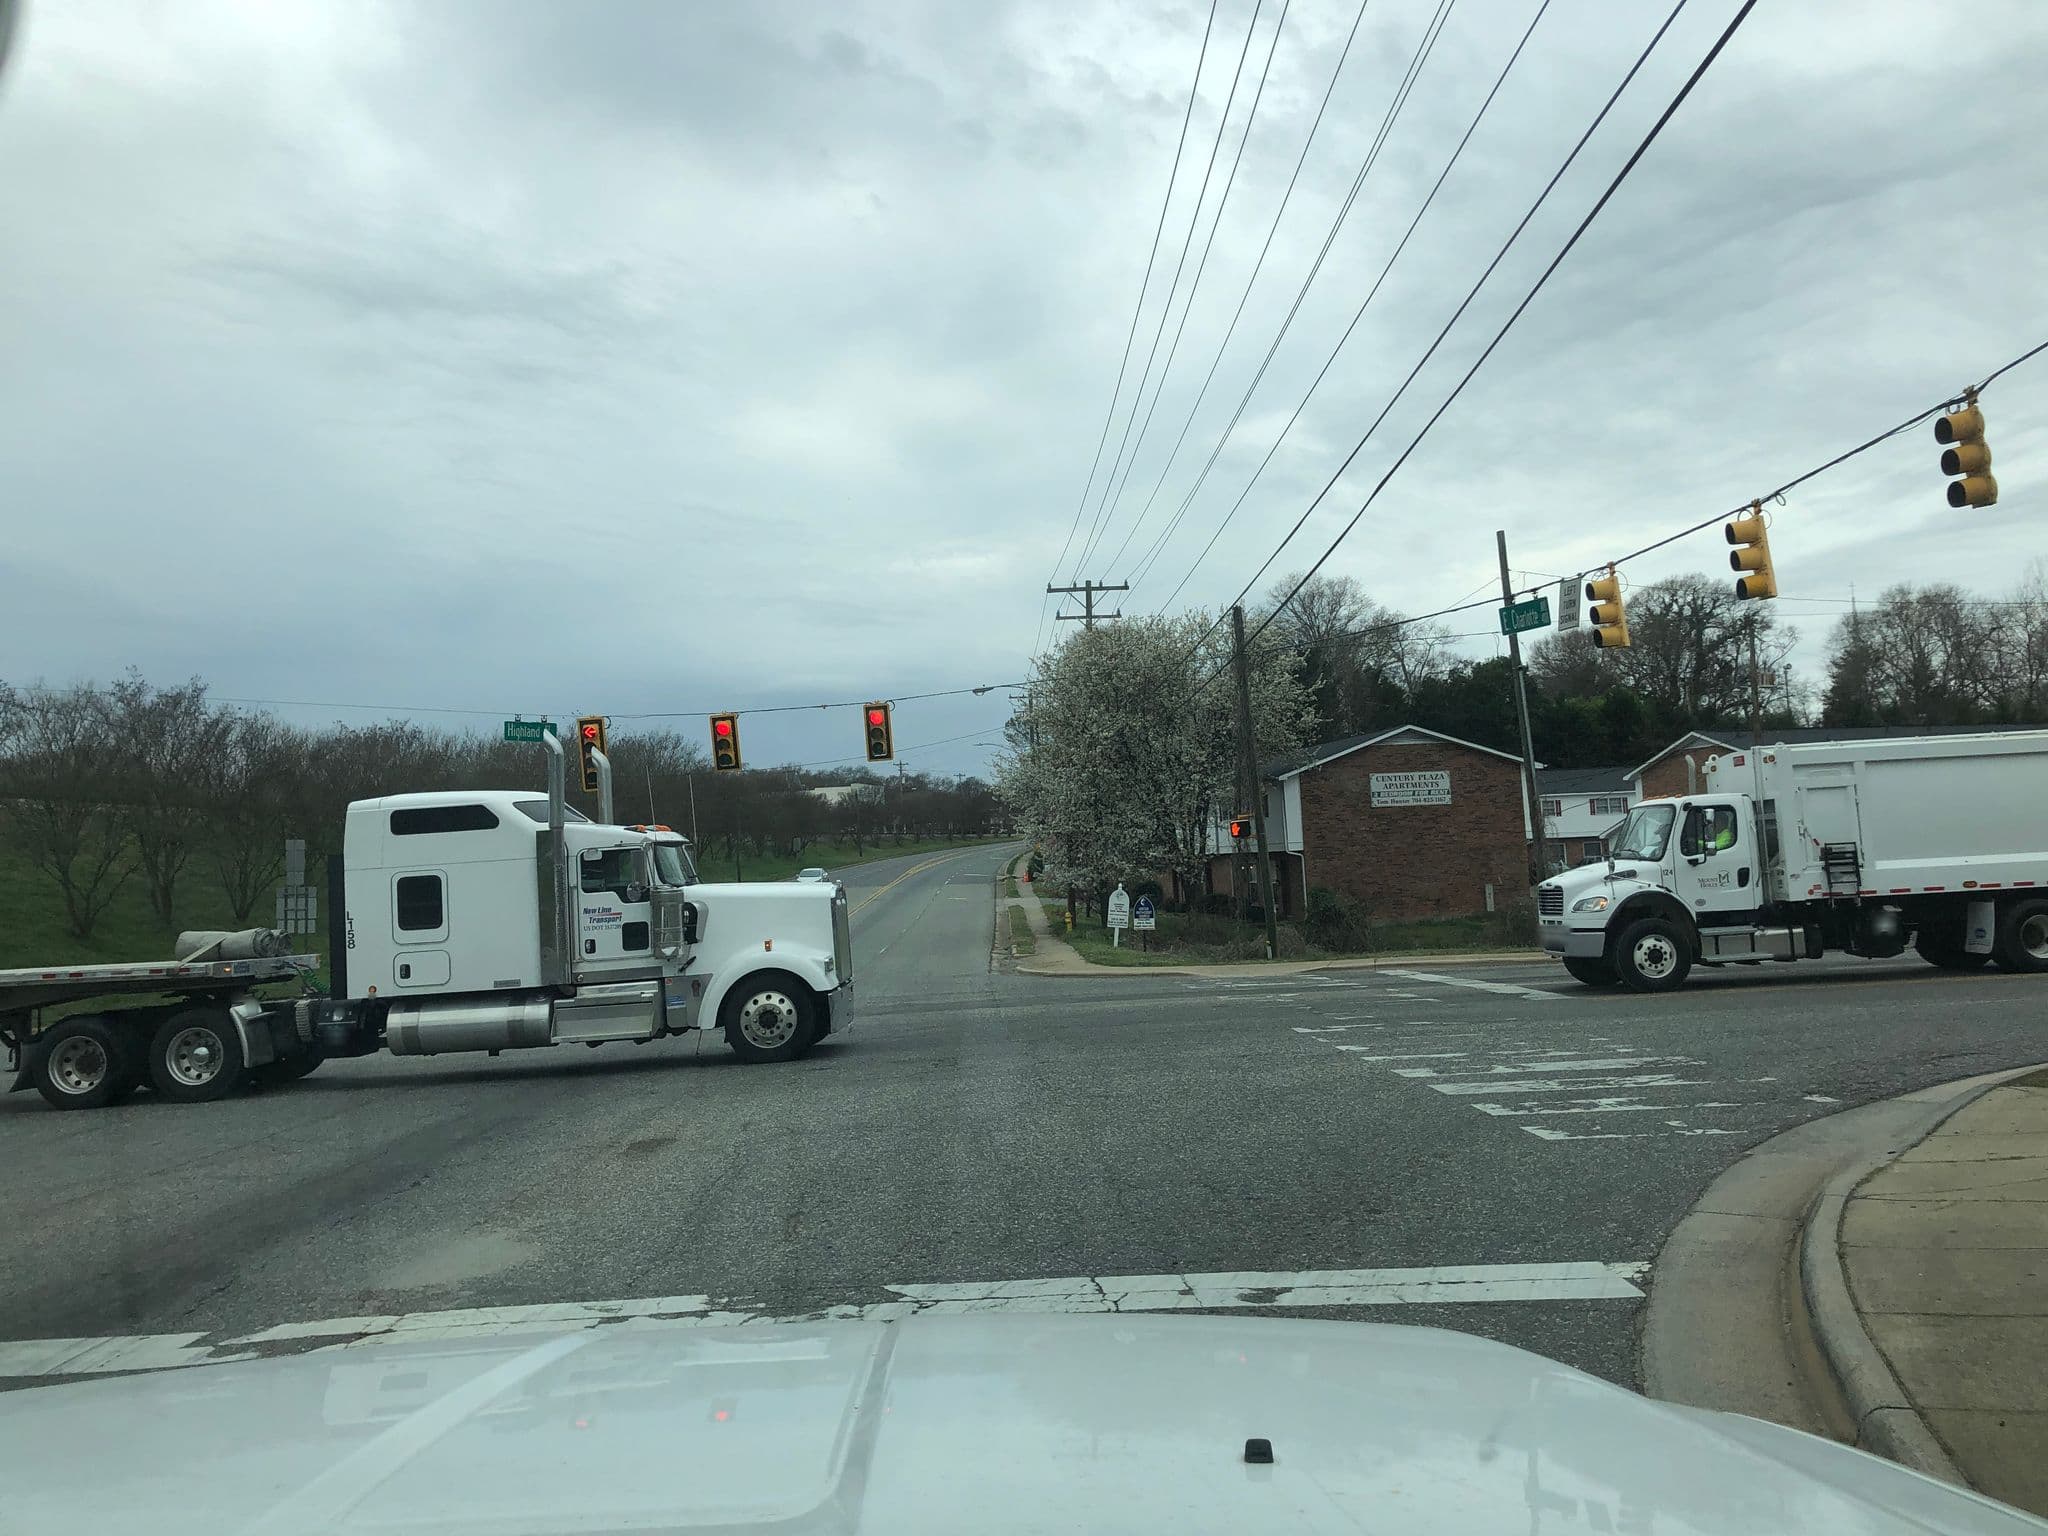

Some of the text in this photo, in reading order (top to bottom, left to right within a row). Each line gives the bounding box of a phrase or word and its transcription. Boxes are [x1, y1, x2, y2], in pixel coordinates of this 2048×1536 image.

[1563, 585, 1577, 596] LEFT
[1563, 600, 1576, 609] TURN
[1560, 612, 1577, 624] SIGNAL
[507, 723, 540, 740] Highland
[1375, 773, 1445, 783] CENTURY PLAZA
[1383, 782, 1440, 790] APARTMENTS
[346, 911, 356, 949] L158
